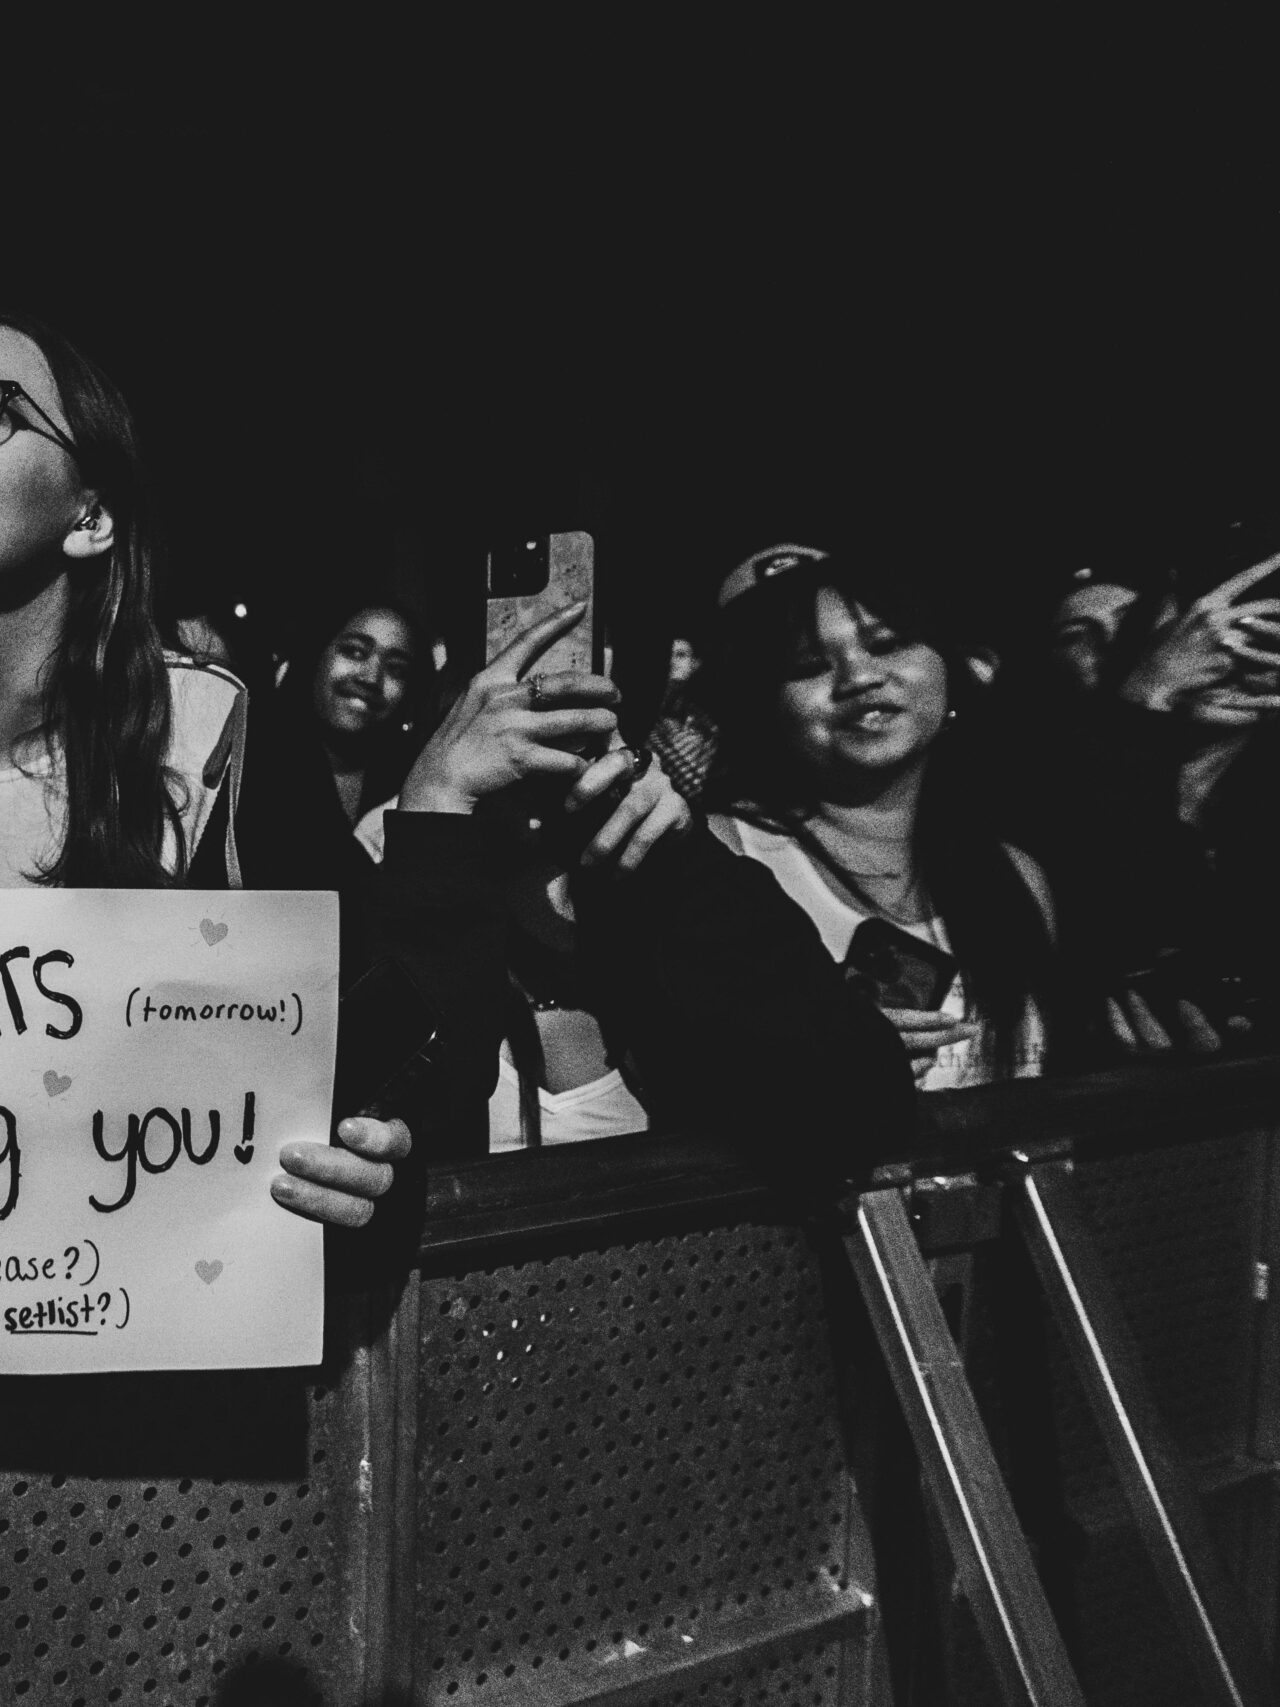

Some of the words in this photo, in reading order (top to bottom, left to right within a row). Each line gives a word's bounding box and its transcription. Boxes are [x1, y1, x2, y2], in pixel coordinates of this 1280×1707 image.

[125, 986, 304, 1035] (tomorrow!)
[88, 1091, 256, 1213] you!
[4, 1287, 130, 1331] setlist?)
